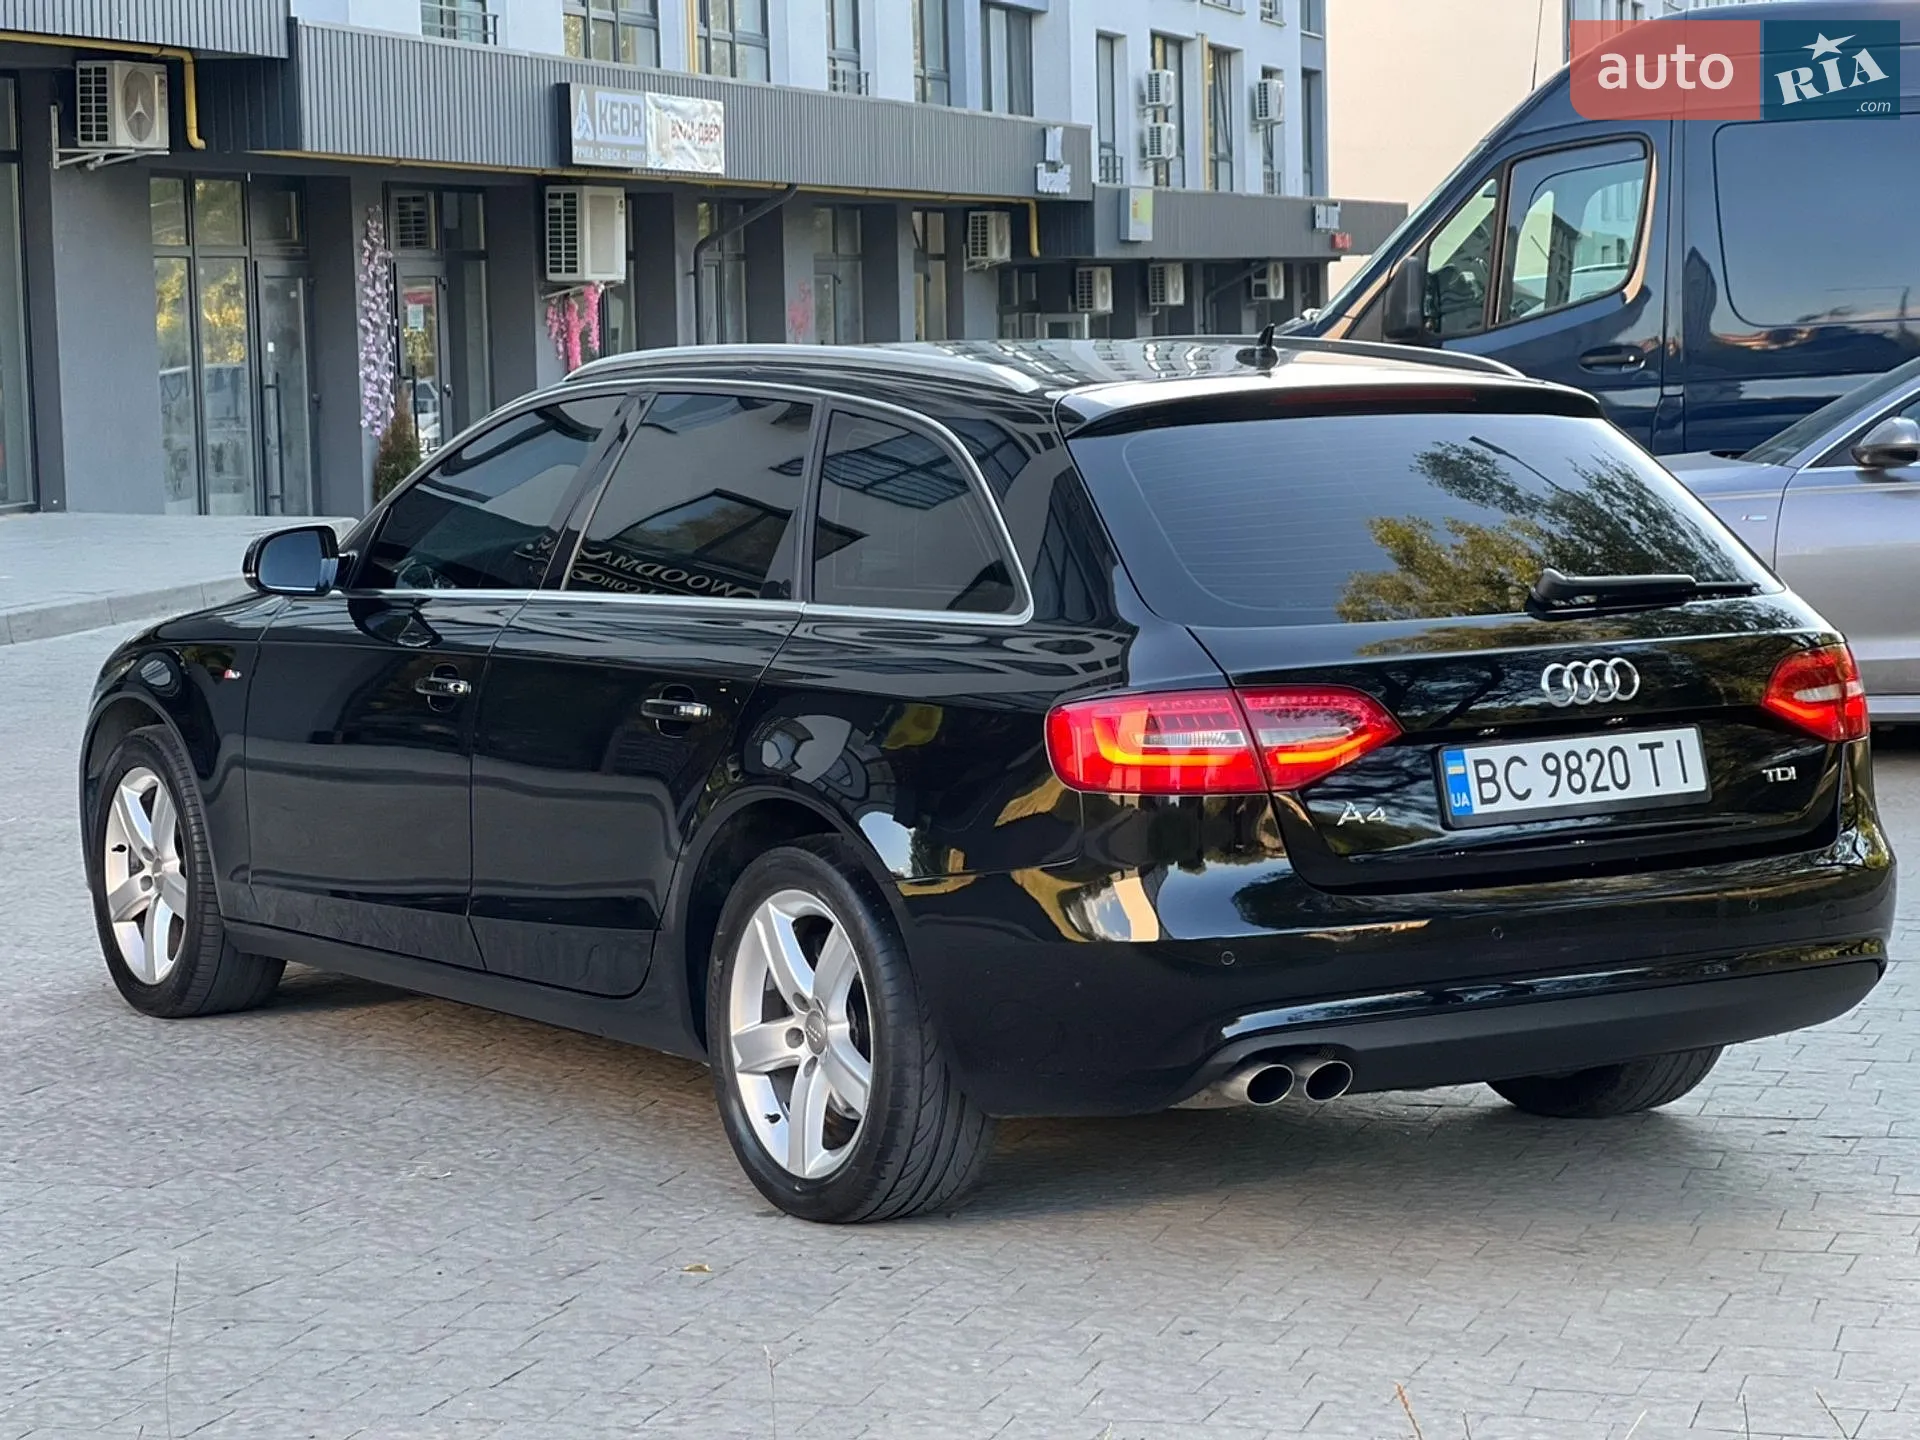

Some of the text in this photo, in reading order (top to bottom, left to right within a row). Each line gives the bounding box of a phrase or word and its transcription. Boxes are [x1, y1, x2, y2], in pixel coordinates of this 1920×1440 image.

[1473, 754, 1532, 806] BC
[1541, 745, 1631, 797] 9820
[1762, 765, 1798, 783] TDI
[1451, 792, 1470, 808] UA
[1336, 800, 1388, 827] A4
